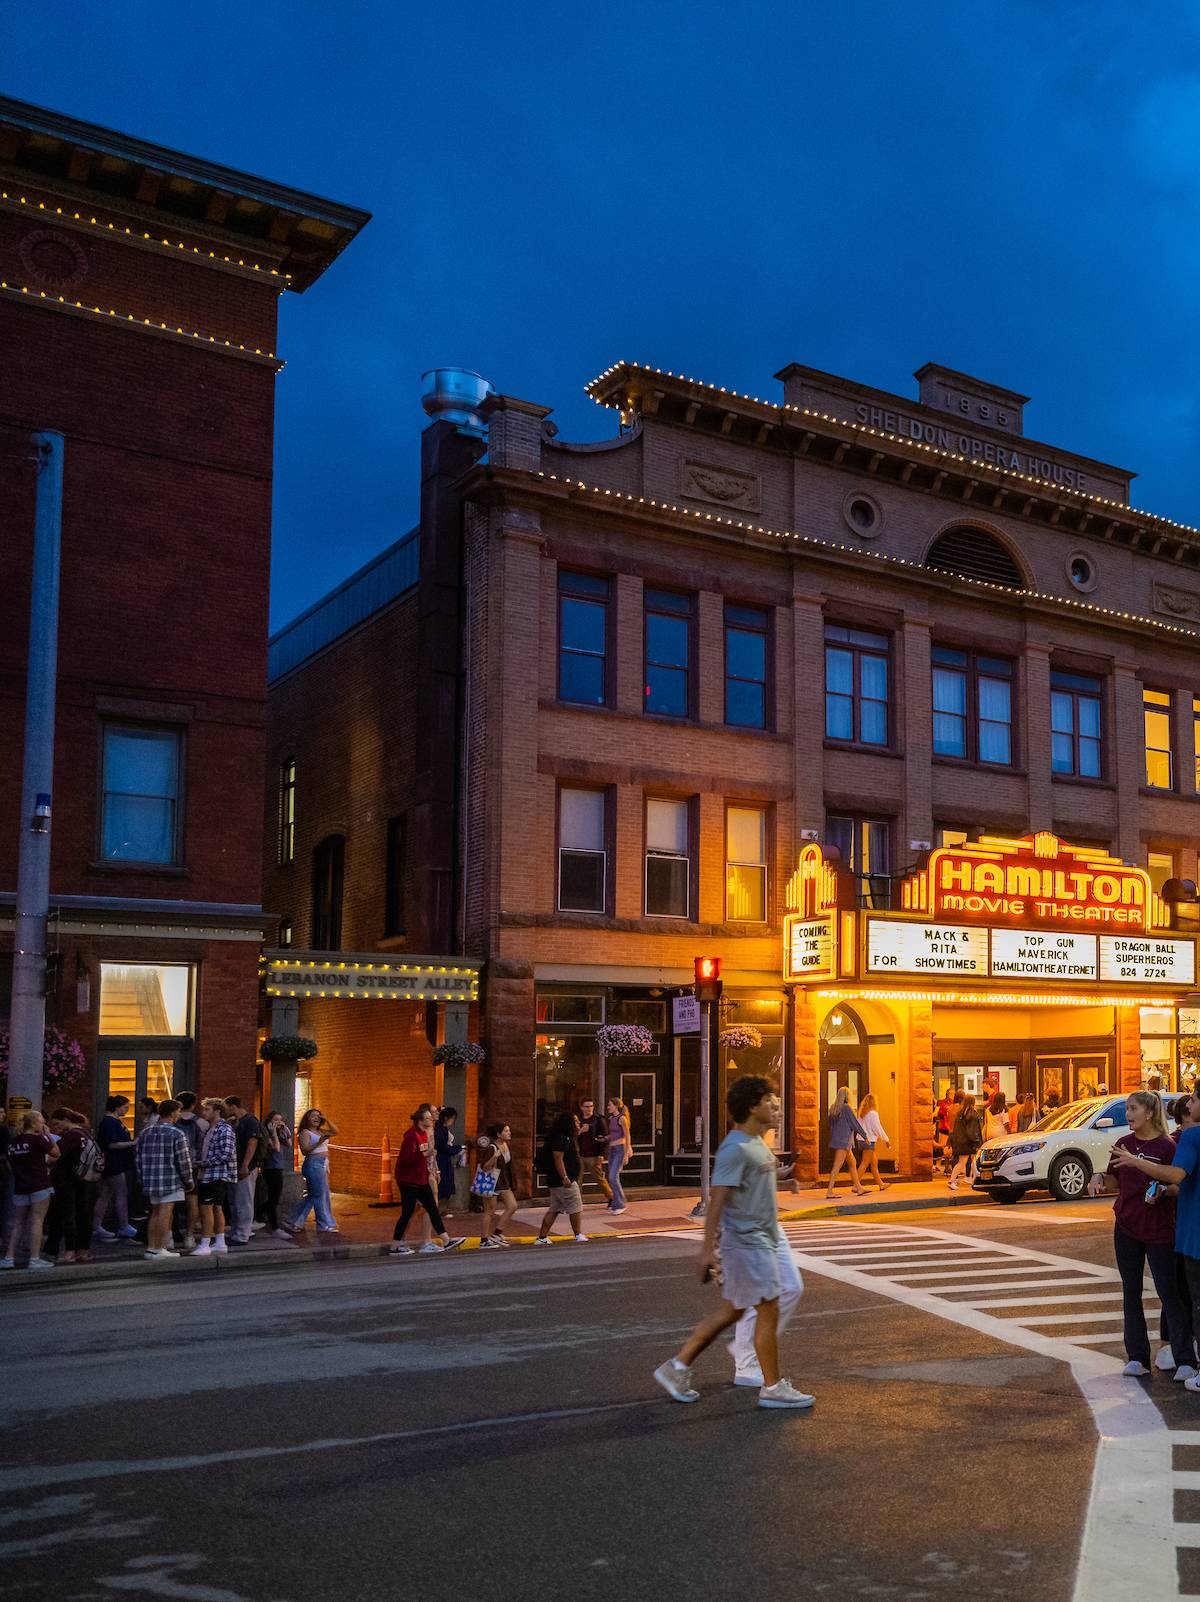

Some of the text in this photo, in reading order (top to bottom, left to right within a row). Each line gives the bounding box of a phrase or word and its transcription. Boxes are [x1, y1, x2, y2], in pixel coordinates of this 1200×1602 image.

[945, 394, 1009, 426] 1895
[856, 404, 1088, 490] SHELDON OPERA HOUSE
[941, 859, 1143, 906] HAMILTON
[941, 895, 1143, 923] MOVIE THEATER
[799, 925, 827, 938] COMING
[924, 929, 956, 941] MACK
[805, 940, 819, 951] THE
[1024, 936, 1074, 948] TOP GUN
[1114, 941, 1176, 954] DRAGON BALL
[931, 943, 958, 954] RITA
[1018, 948, 1069, 960] MAVERICK
[801, 955, 821, 966] GUIDE
[873, 955, 977, 970] FOR SHOWTIMES
[1115, 954, 1174, 965] SUPERHEROS
[1120, 967, 1166, 978] 824 2724
[270, 972, 473, 991] LEBANON STREET ALLEY
